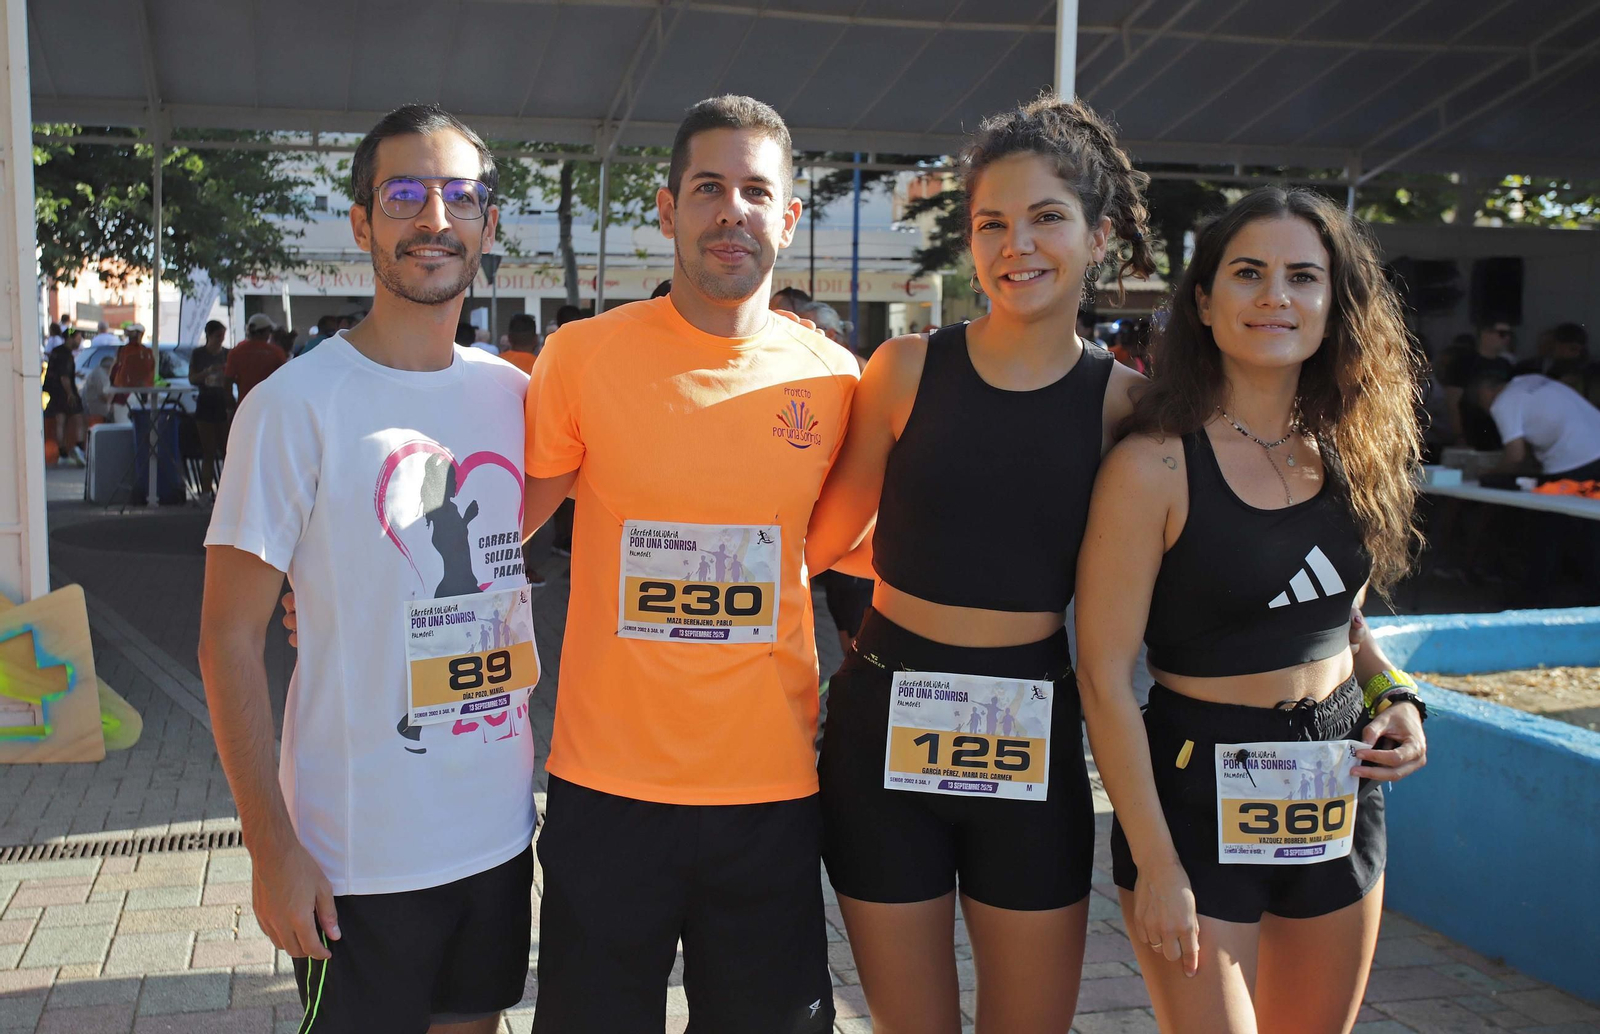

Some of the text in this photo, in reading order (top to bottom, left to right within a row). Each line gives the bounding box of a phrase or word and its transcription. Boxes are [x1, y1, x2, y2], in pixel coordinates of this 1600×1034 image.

[478, 531, 520, 548] CARRER
[630, 536, 697, 551] POR UNA SONRISA
[484, 547, 523, 564] SOLIDA
[638, 581, 762, 616] 230
[411, 611, 476, 629] POR UNA SONRISA
[716, 619, 732, 627] PABLO
[684, 630, 712, 638] SEPTIEMBRE
[712, 630, 724, 638] 2025
[752, 628, 759, 636] M
[449, 650, 512, 690] 89
[463, 691, 474, 700] DÍAZ
[489, 686, 505, 696] MANUEL
[898, 686, 968, 702] POR UNA SONRISA
[475, 700, 498, 710] SEPTIEMBRE
[913, 732, 1031, 771] 125
[1223, 759, 1240, 769] POR
[1261, 759, 1297, 770] SONRISA
[922, 767, 941, 775] GARCÍA
[990, 773, 1012, 781] CARMEN
[954, 782, 980, 790] SEPTIEMBRE
[980, 783, 992, 791] 2025
[1026, 784, 1032, 792] M
[1239, 799, 1346, 834] 360
